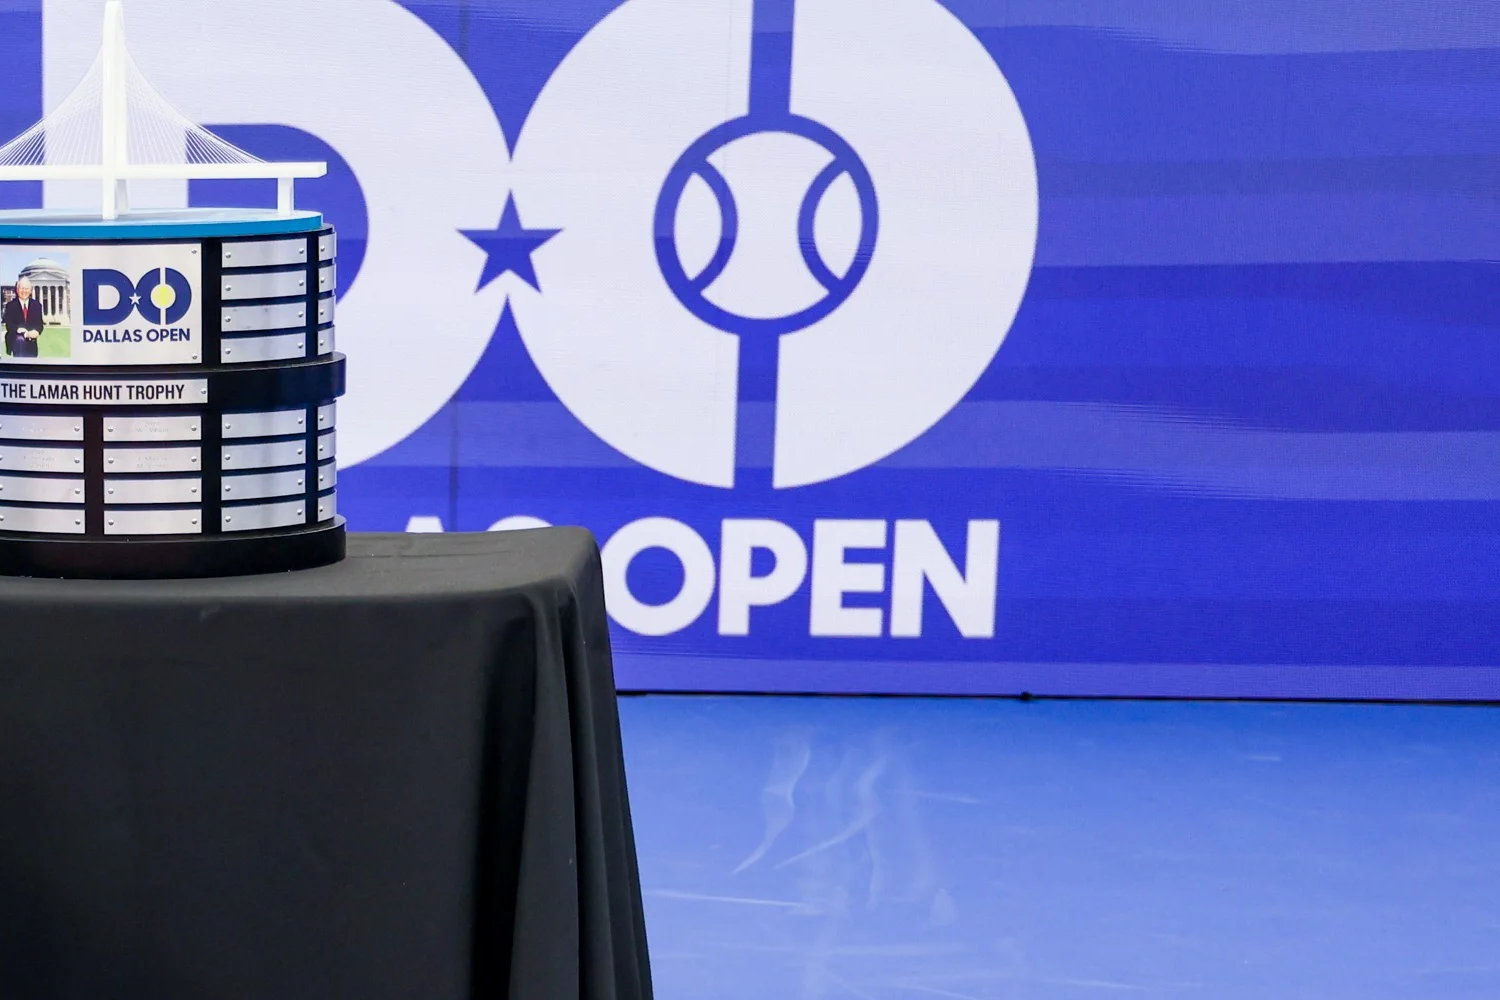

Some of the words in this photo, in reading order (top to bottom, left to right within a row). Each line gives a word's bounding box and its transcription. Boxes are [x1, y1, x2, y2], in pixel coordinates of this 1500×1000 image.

[82, 328, 143, 343] DALLAS
[146, 328, 191, 342] OPEN
[0, 383, 27, 399] THE
[30, 384, 79, 400] LAMAR
[83, 385, 123, 400] HUNT
[126, 384, 185, 400] TROPHY
[600, 516, 999, 639] OPEN
